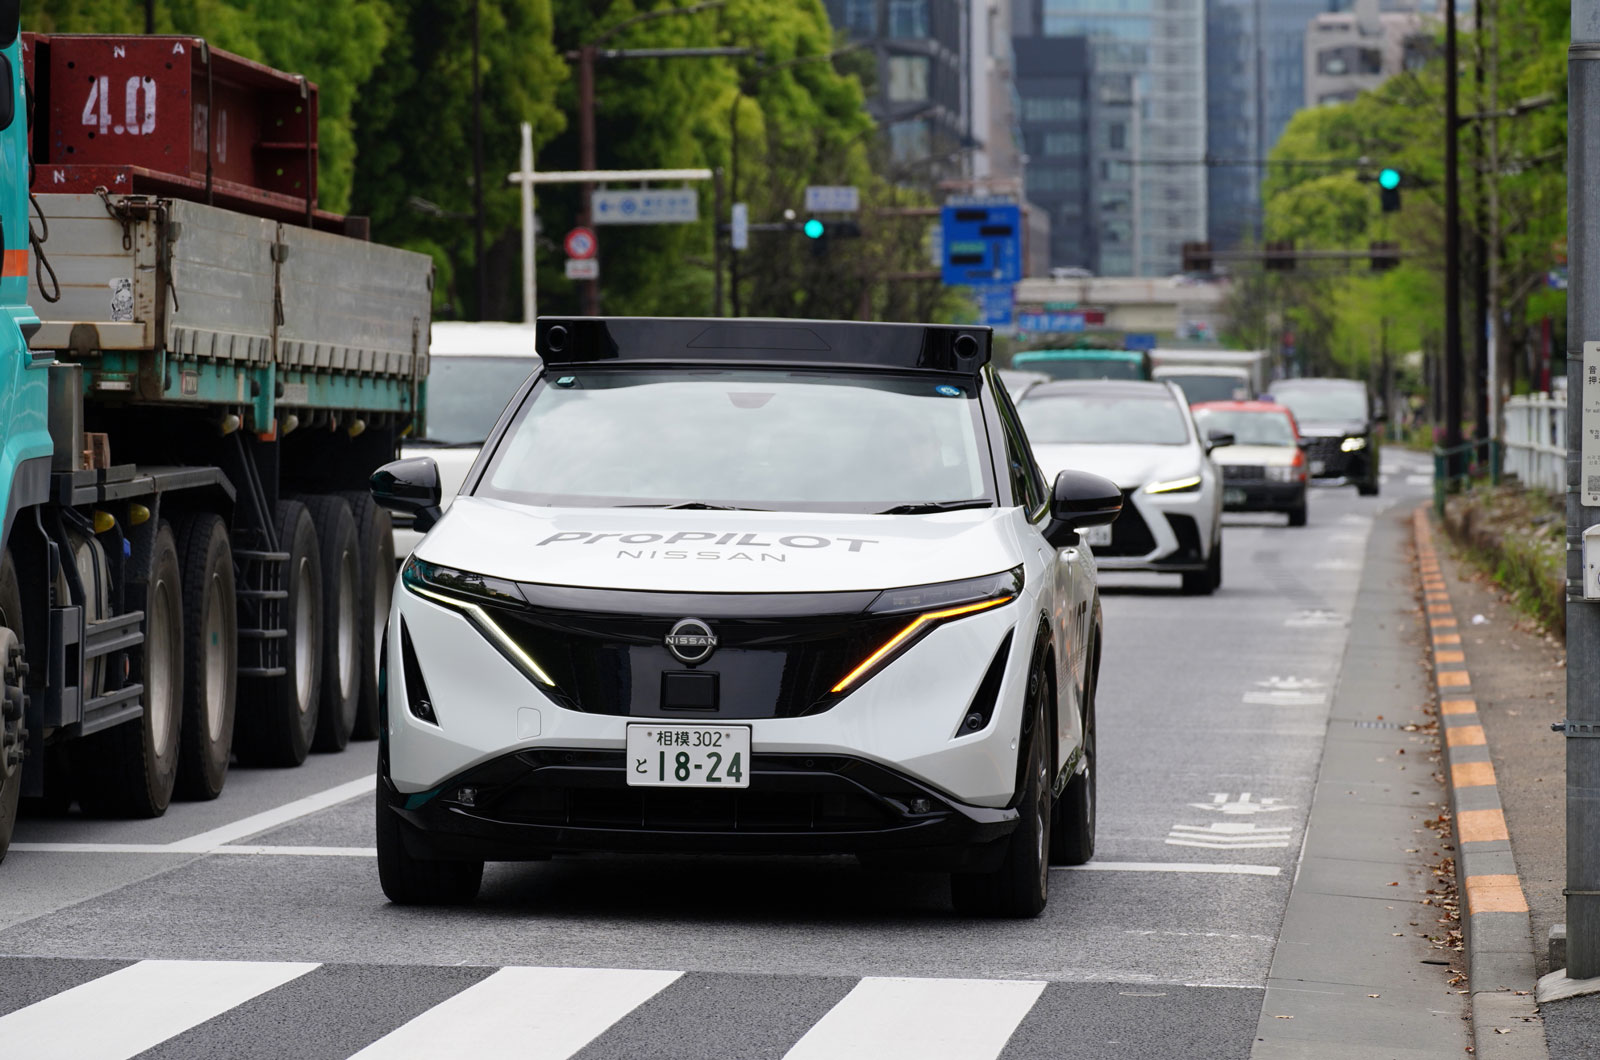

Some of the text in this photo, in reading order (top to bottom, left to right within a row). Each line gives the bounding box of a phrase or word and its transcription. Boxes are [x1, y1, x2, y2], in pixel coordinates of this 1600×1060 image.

[113, 45, 126, 58] N
[172, 42, 185, 54] A
[82, 75, 157, 135] 4.0
[53, 170, 65, 183] N
[616, 550, 786, 562] NISSAN
[665, 636, 717, 646] NISSAN
[636, 751, 742, 783] と 18-24
